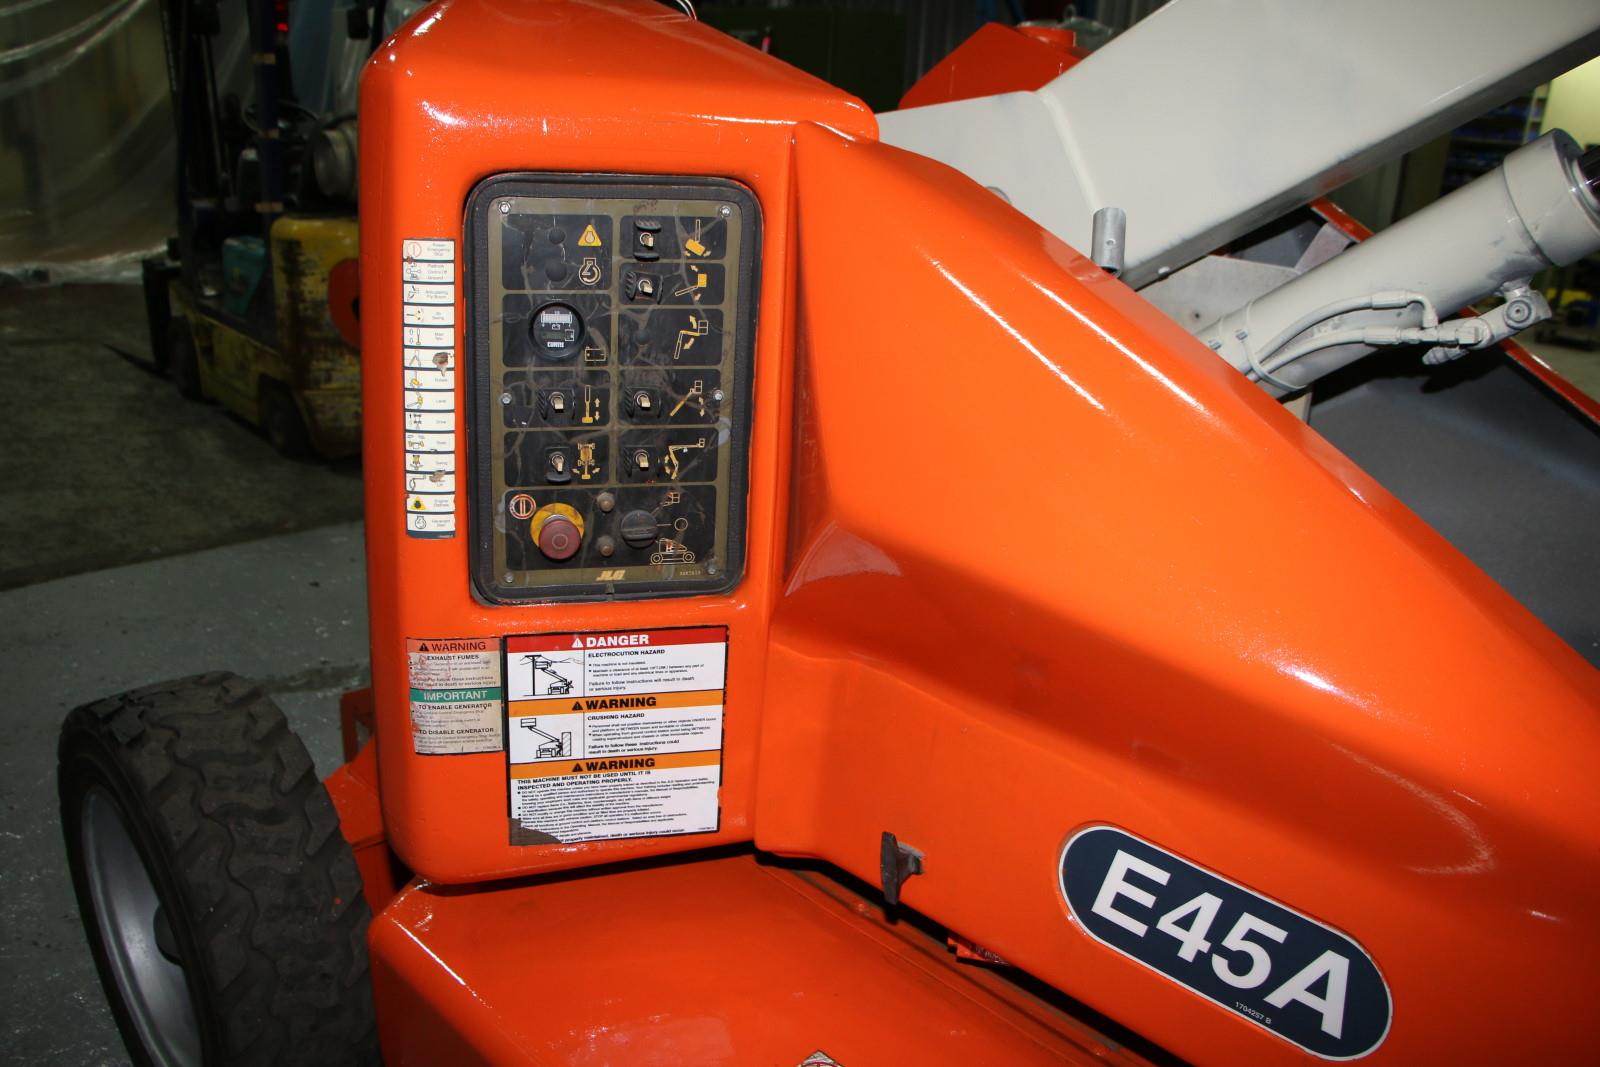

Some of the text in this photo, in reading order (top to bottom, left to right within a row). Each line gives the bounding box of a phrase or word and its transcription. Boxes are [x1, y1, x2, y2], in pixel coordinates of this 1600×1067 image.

[596, 570, 626, 580] JLG
[432, 642, 486, 652] WARNING
[586, 634, 649, 648] DANGER
[423, 690, 488, 700] IMPORTANT
[586, 696, 656, 710] WARNING
[586, 758, 655, 771] WARNING
[1091, 849, 1350, 1040] E45A
[1235, 1001, 1264, 1020] 1704257
